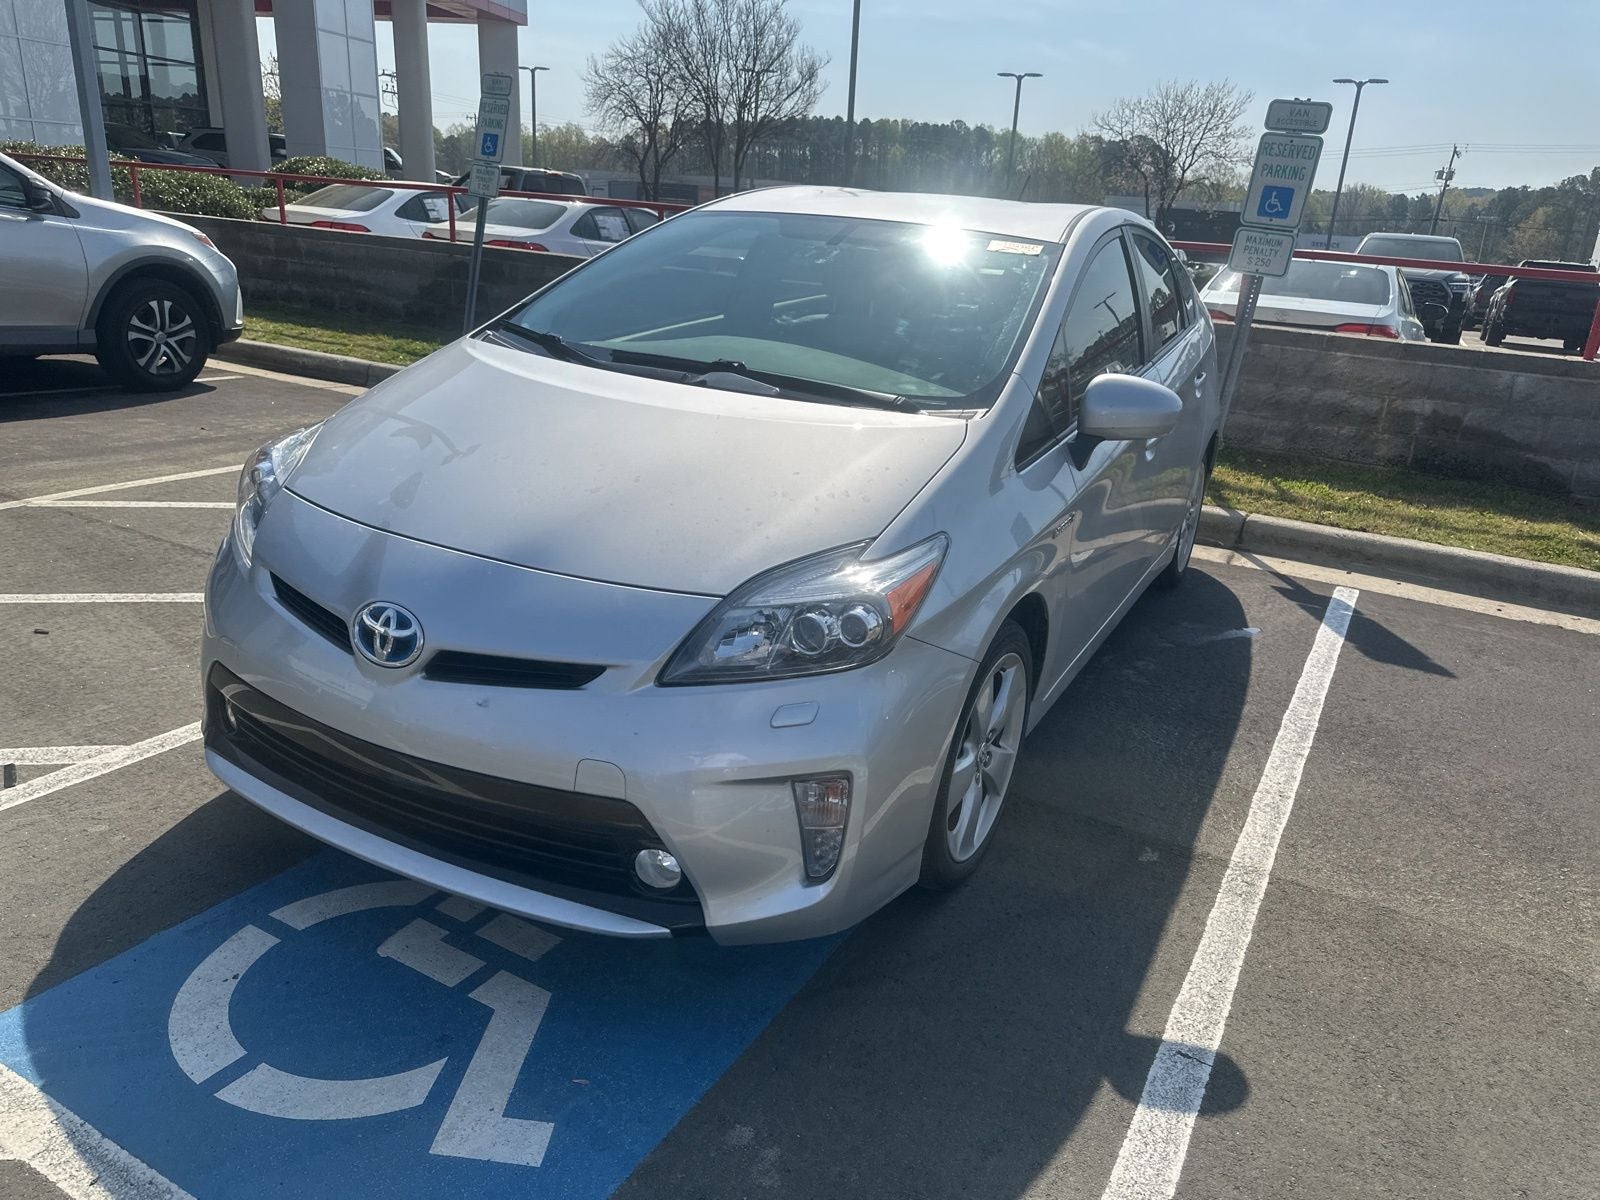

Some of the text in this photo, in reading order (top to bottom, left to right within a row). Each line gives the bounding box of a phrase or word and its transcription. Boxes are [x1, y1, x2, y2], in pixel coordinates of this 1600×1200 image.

[1289, 107, 1310, 118] VAN
[1262, 142, 1316, 160] RESERVED
[1260, 163, 1306, 180] PARKING
[1245, 235, 1283, 247] MAXIMUM
[1243, 245, 1279, 257] PENALTY
